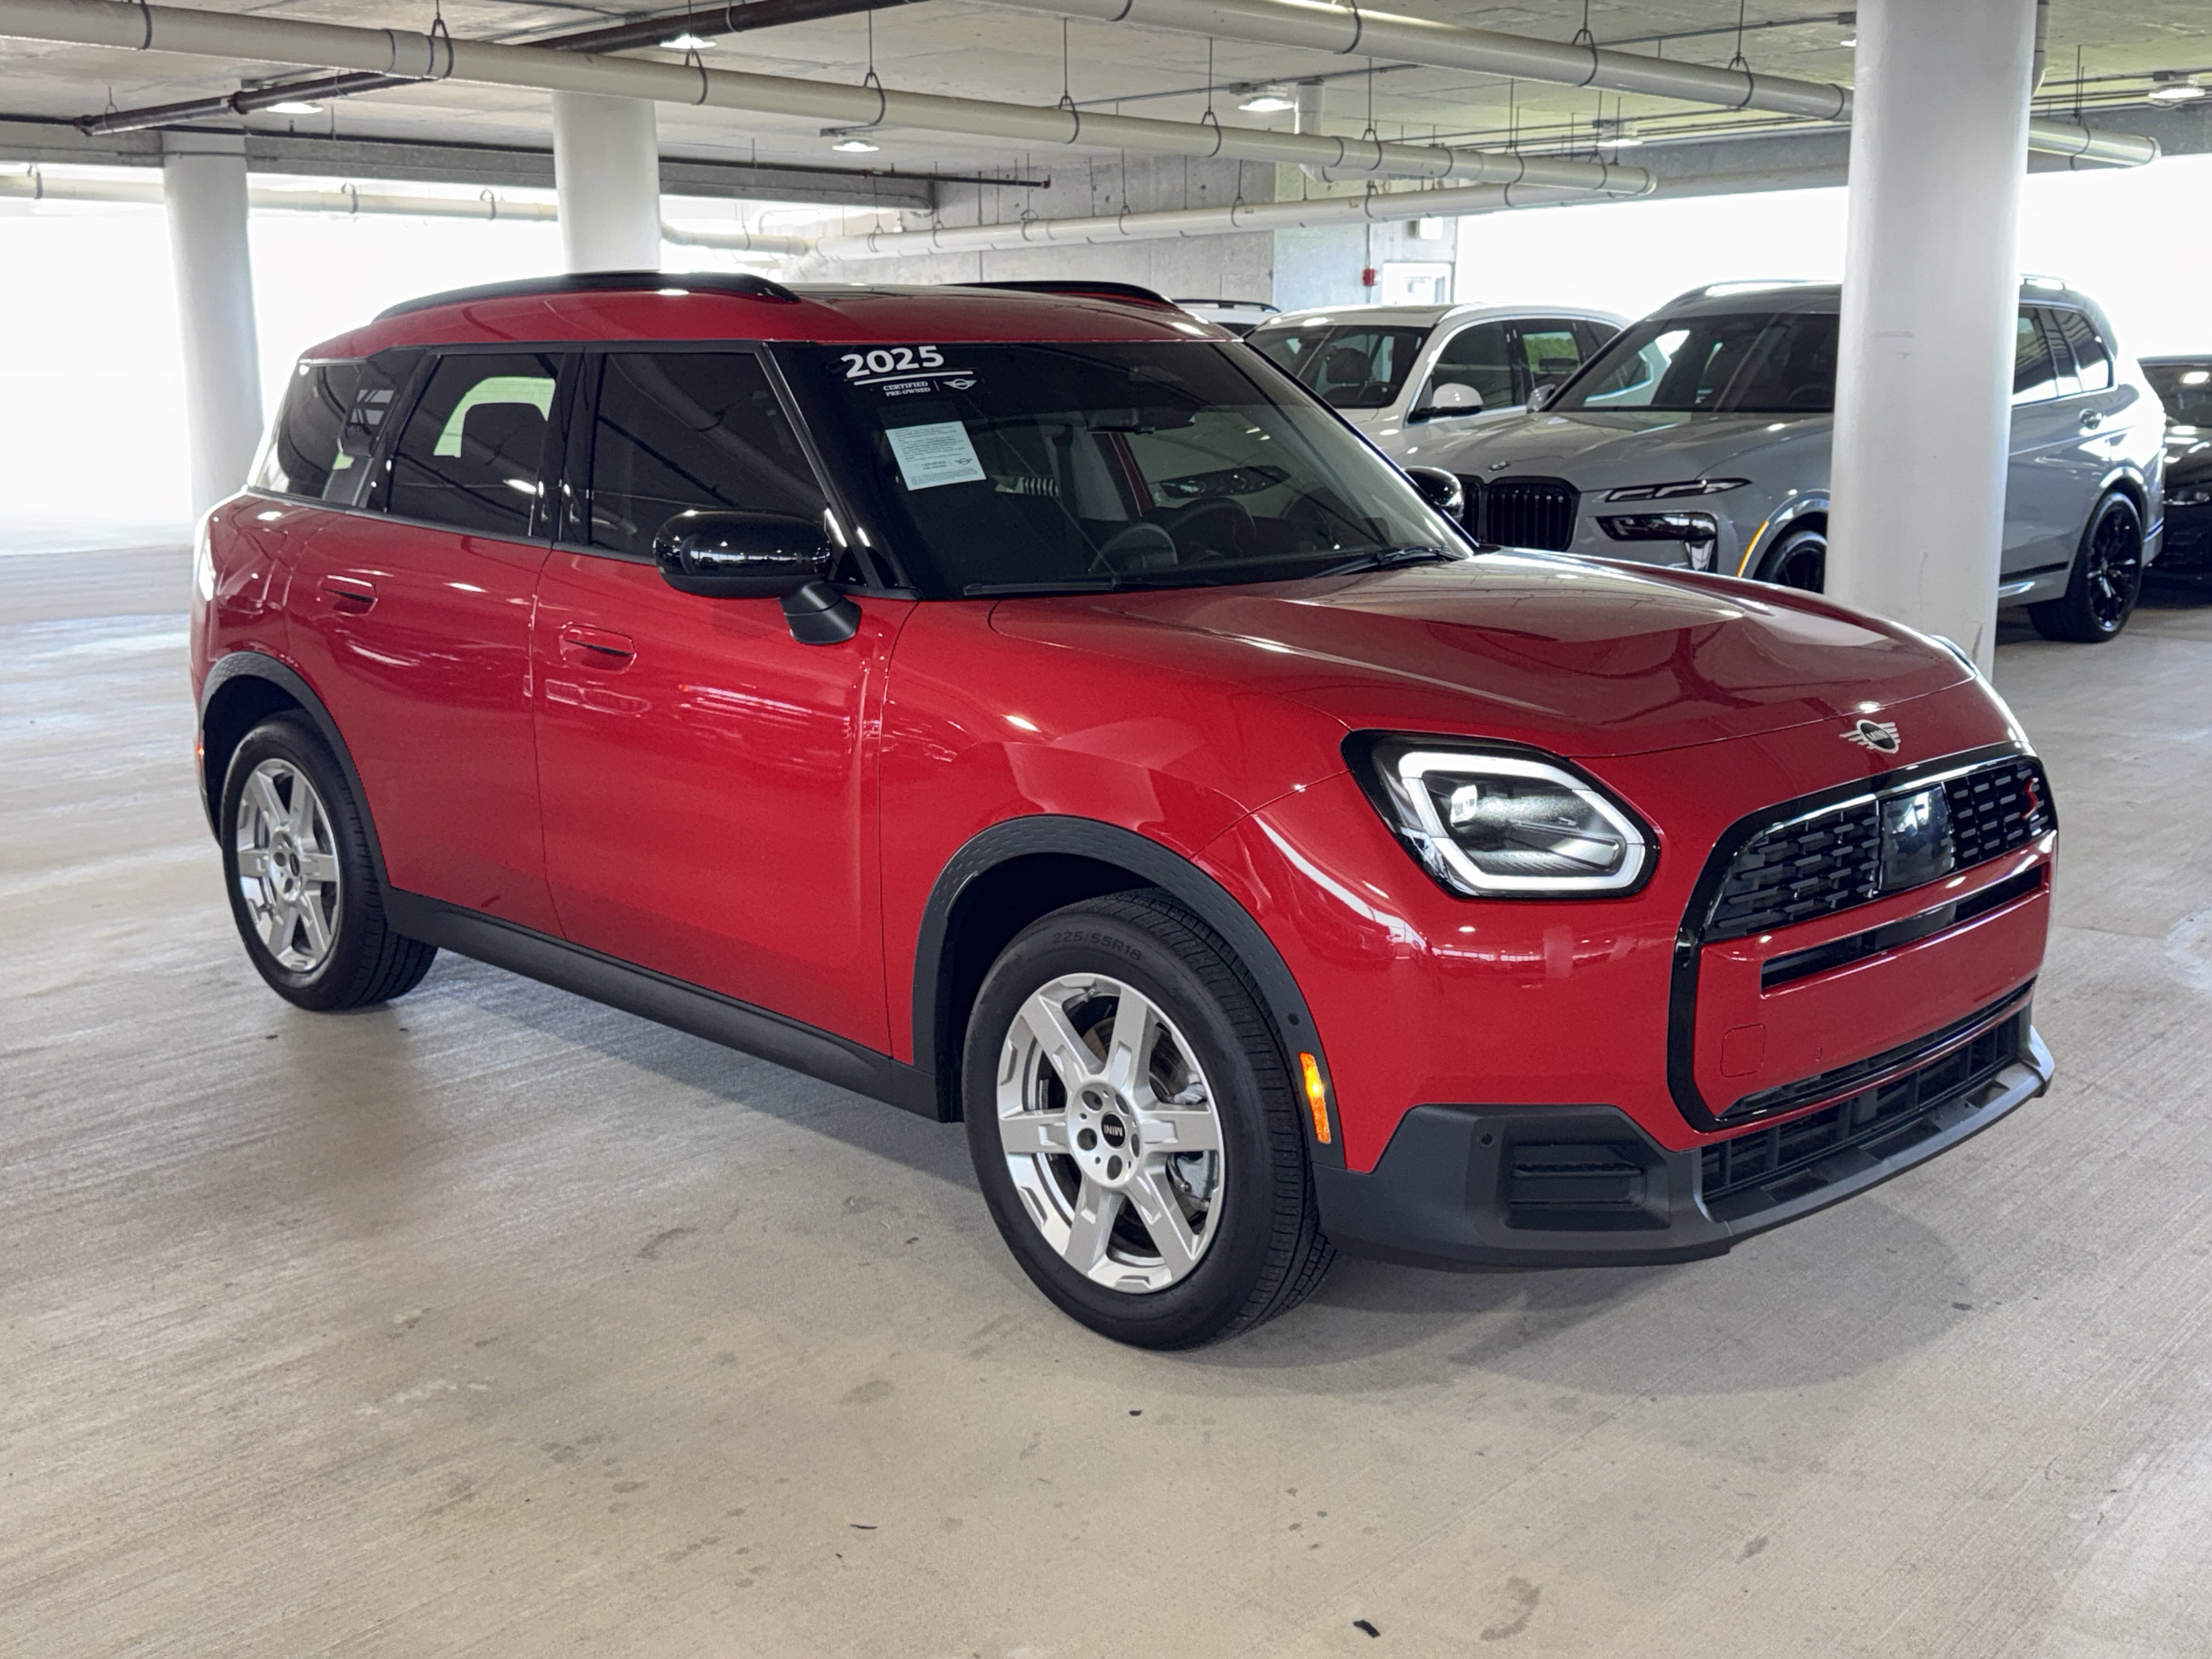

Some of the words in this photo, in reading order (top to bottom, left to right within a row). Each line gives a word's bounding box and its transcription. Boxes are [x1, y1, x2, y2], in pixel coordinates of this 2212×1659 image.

[840, 345, 944, 379] 2025
[883, 381, 928, 391] CERTIFIED
[885, 387, 931, 397] PRE-OWNED
[1865, 729, 1891, 742] MINI
[1103, 1124, 1124, 1137] MINI
